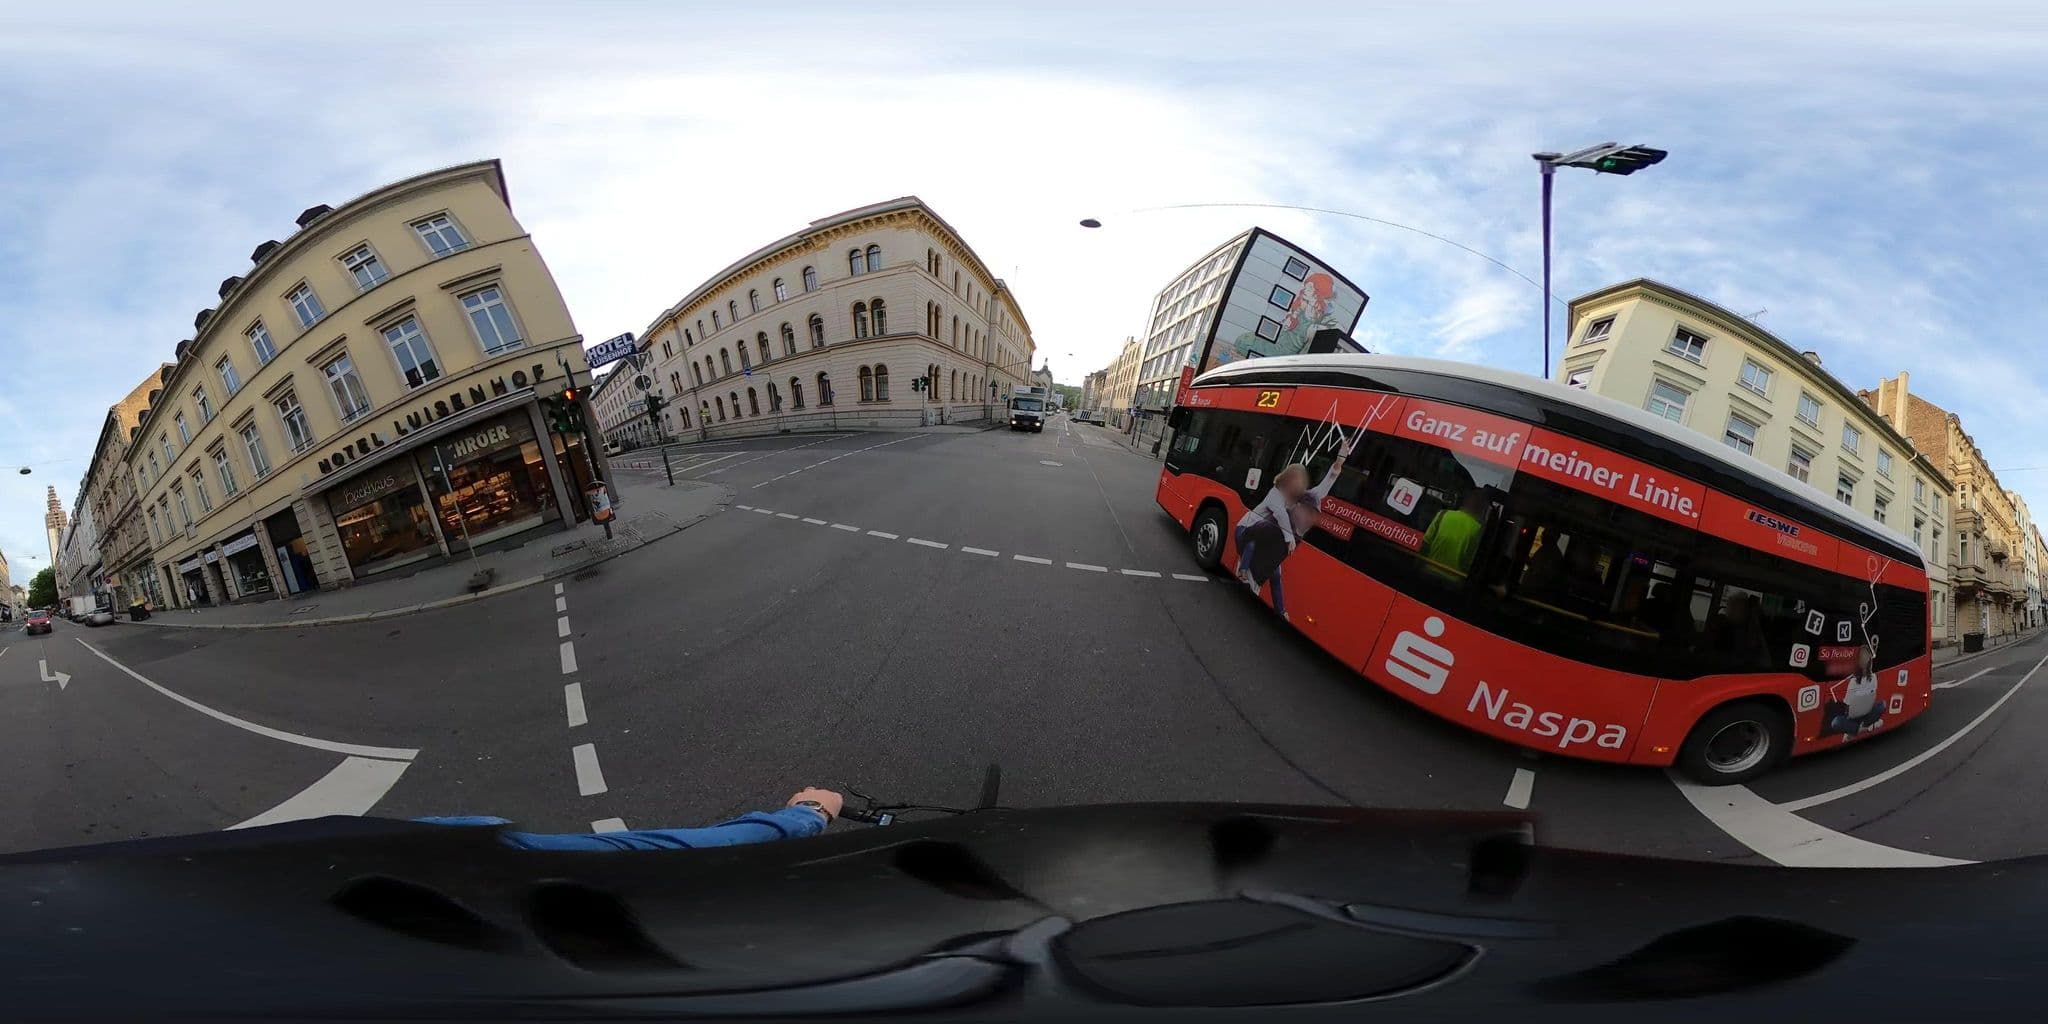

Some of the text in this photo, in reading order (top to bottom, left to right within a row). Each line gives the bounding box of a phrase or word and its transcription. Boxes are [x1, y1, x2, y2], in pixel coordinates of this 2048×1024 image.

[587, 335, 633, 360] HOTEL
[592, 345, 633, 367] LUISENHOF
[317, 364, 545, 475] HOTEL LUISENHOF
[1257, 391, 1280, 408] 23
[447, 425, 511, 459] HRÖER
[1406, 410, 1699, 519] Ganz auf meiner Linie.
[1324, 498, 1418, 547] So partnerschaftlich
[1466, 680, 1627, 750] Naspa
